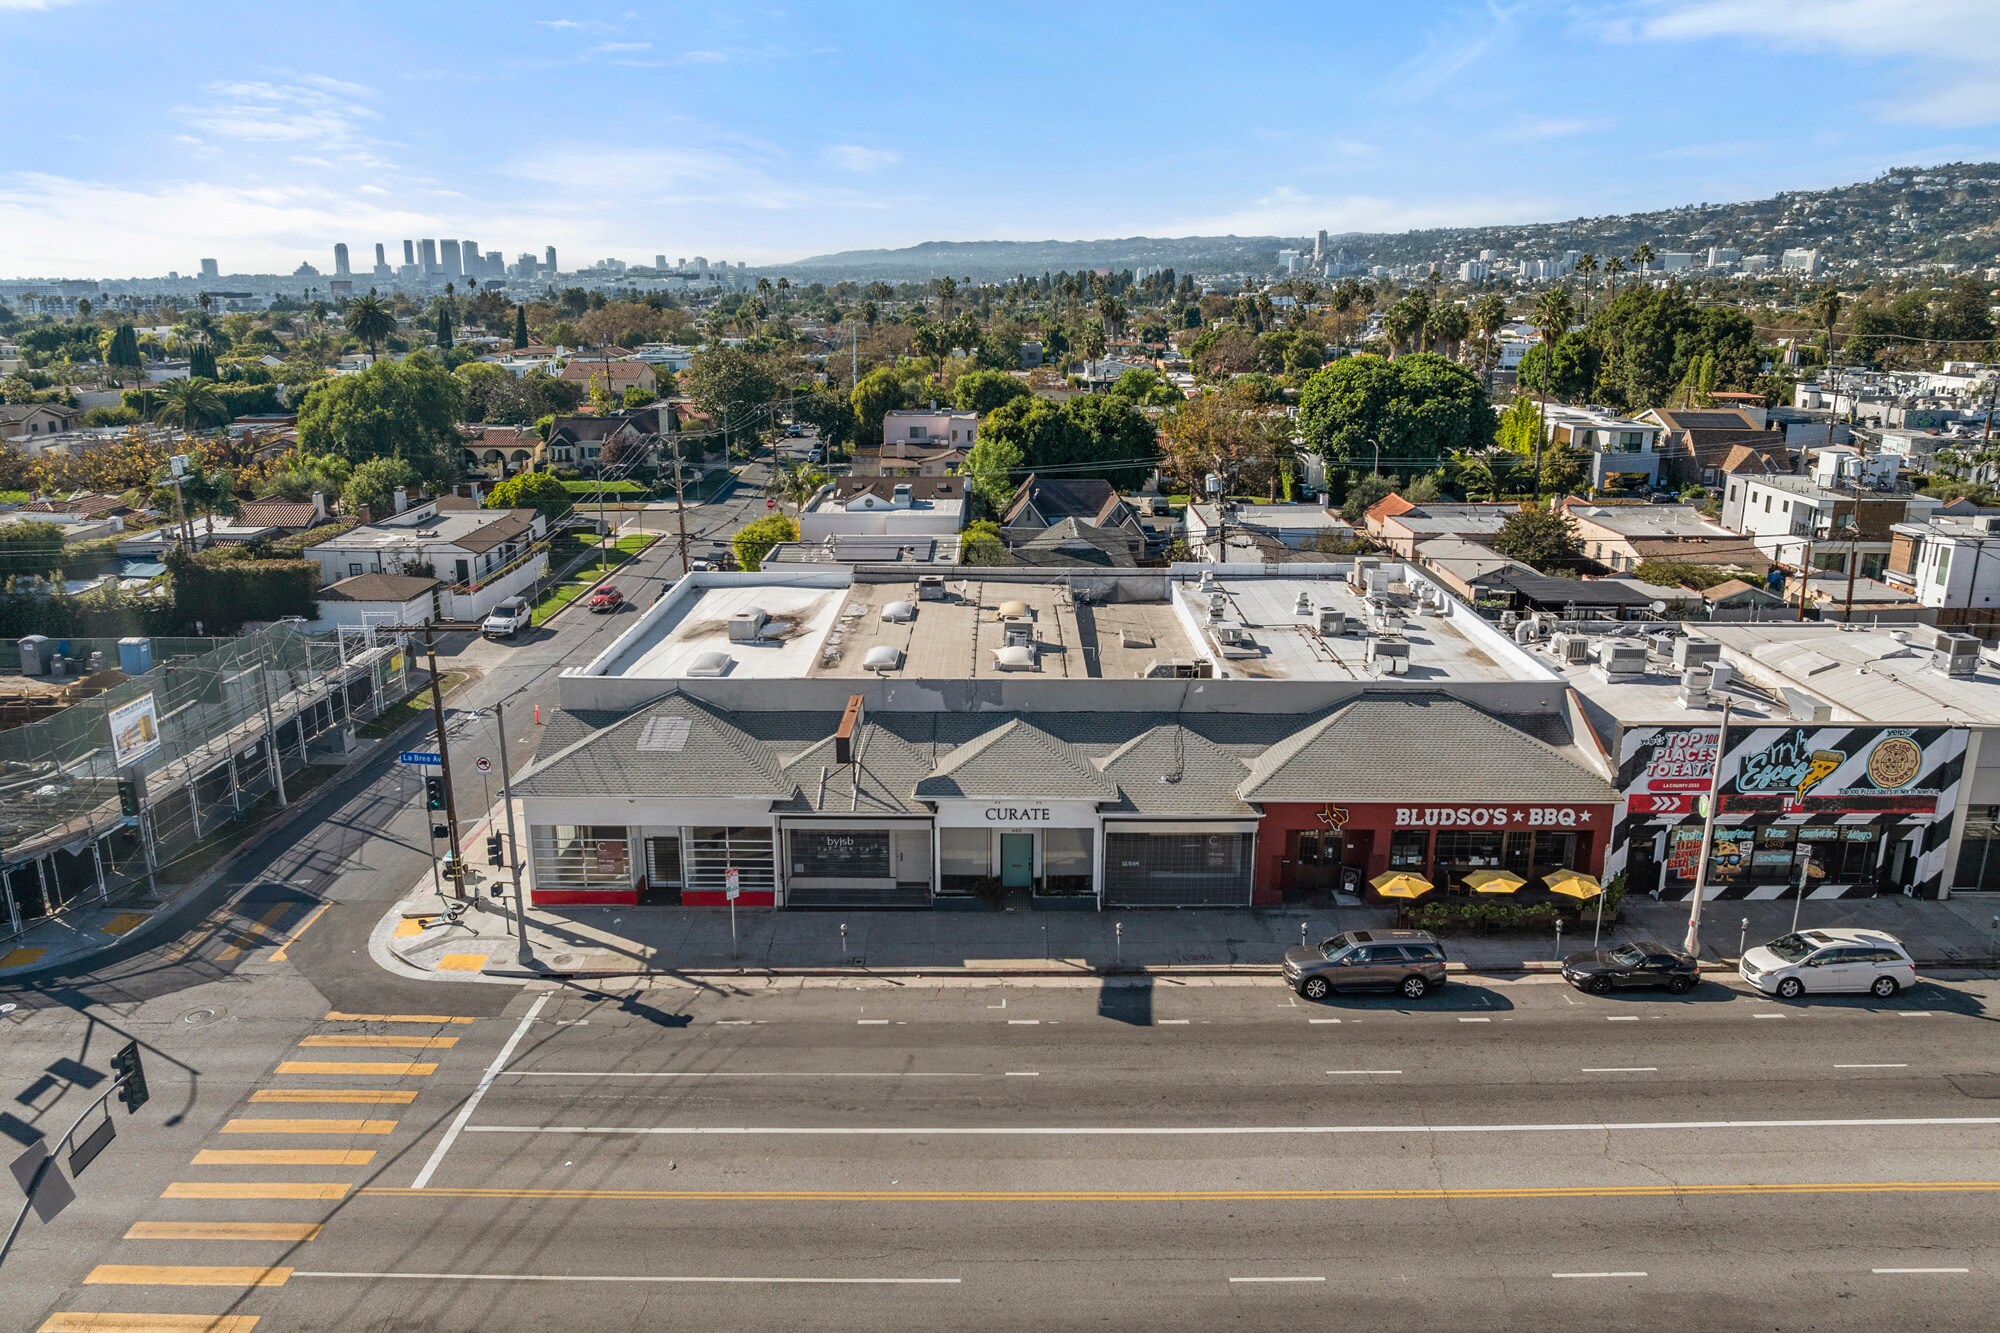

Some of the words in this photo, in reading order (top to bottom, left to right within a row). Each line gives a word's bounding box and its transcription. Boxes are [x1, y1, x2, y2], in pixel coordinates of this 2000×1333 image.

[1887, 729, 1905, 737] yelp
[1665, 732, 1703, 748] TOP
[1883, 743, 1898, 753] TOP
[1898, 743, 1911, 753] 100
[403, 754, 412, 762] La
[414, 754, 430, 763] Brea
[1652, 747, 1717, 763] PLACES
[1647, 762, 1671, 777] TO
[1671, 762, 1707, 777] EAT
[1873, 766, 1890, 783] PIZZA
[1890, 766, 1913, 783] SPOTS
[985, 808, 1050, 821] CURATE
[1395, 808, 1507, 826] BLUDSO'S
[1528, 808, 1577, 827] BBQ
[827, 836, 854, 848] byjsb
[1680, 866, 1699, 877] WIN
